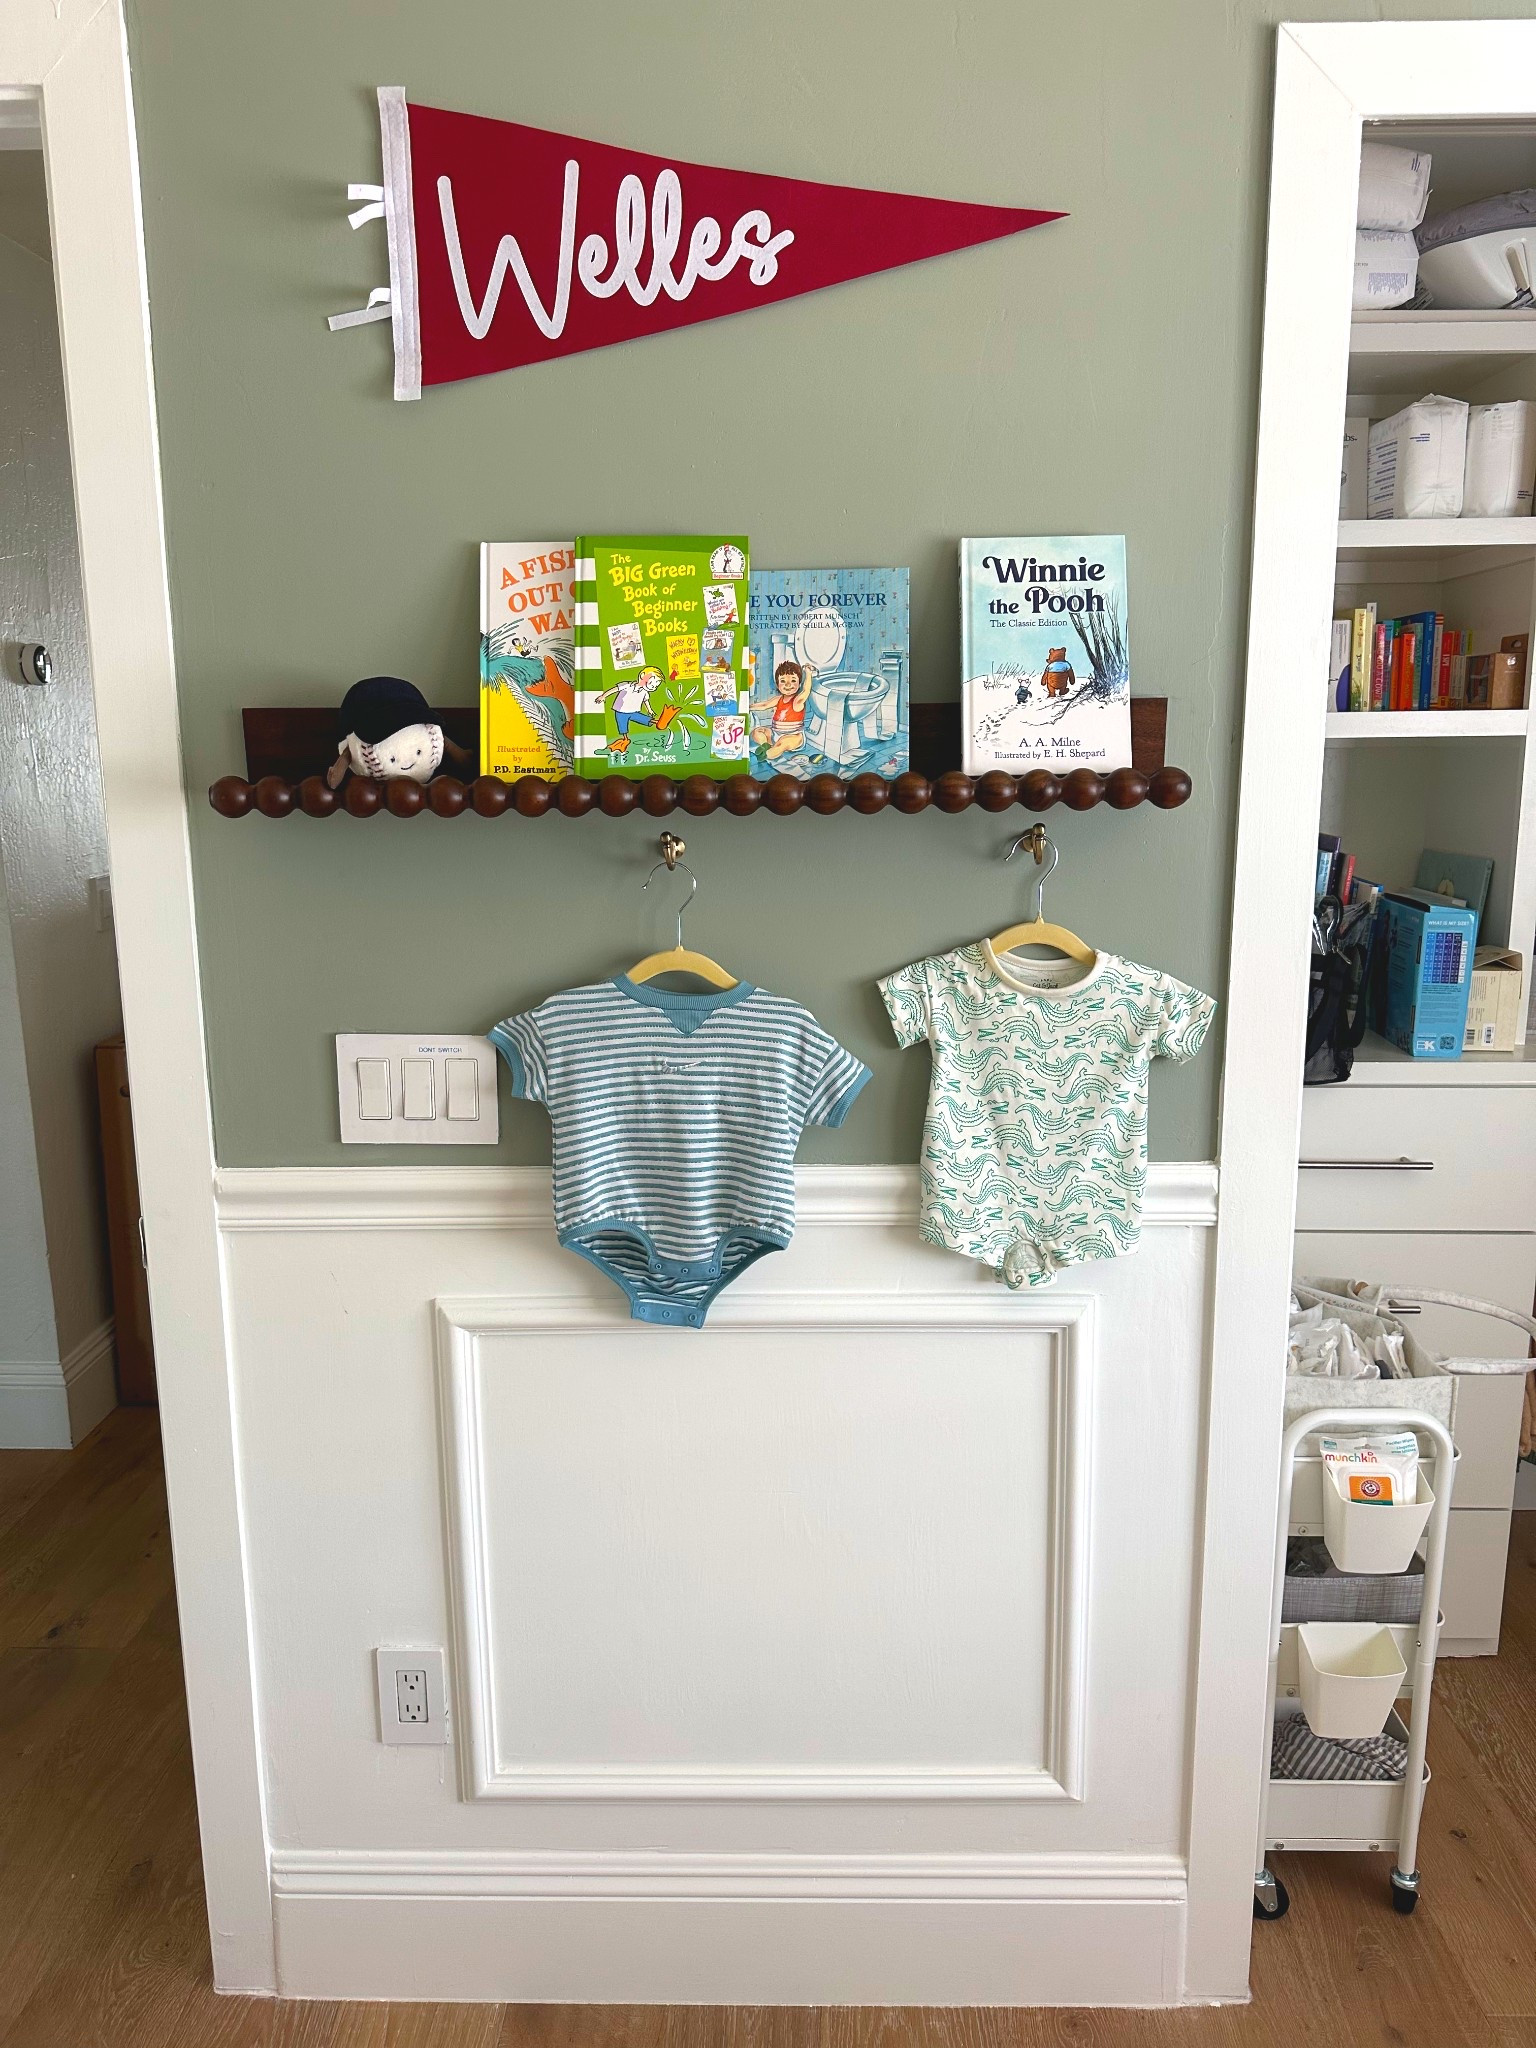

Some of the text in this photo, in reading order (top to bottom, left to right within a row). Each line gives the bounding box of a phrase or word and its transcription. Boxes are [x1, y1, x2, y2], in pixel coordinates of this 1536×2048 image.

[436, 159, 795, 340] Welles
[610, 553, 632, 566] The
[608, 562, 696, 587] BIG Green
[982, 556, 1106, 583] Winnie
[500, 567, 519, 591] A
[508, 582, 564, 614] OUT
[622, 583, 677, 601] Book of
[765, 594, 803, 608] YOU
[809, 592, 888, 607] FOREVER
[988, 585, 1106, 615] the Pooh
[631, 600, 698, 619] Beginner
[781, 613, 793, 621] BY
[793, 613, 824, 621] ROBERT
[825, 612, 860, 620] MUNSCH
[642, 619, 688, 637] Books
[750, 622, 790, 630] USTRATED
[791, 621, 802, 629] BY
[803, 621, 830, 629] SHEILA
[989, 619, 1068, 628] The Classic Edition
[722, 727, 744, 745] UP
[1018, 737, 1081, 748] A. A. Milne
[497, 745, 541, 753] Illustrated
[994, 748, 1106, 760] Illustrated by E. H. Shepard
[512, 755, 523, 763] by
[634, 751, 677, 766] Dr. Seuss
[494, 765, 557, 775] P.D. Eastman
[1325, 1451, 1378, 1463] munchkin
